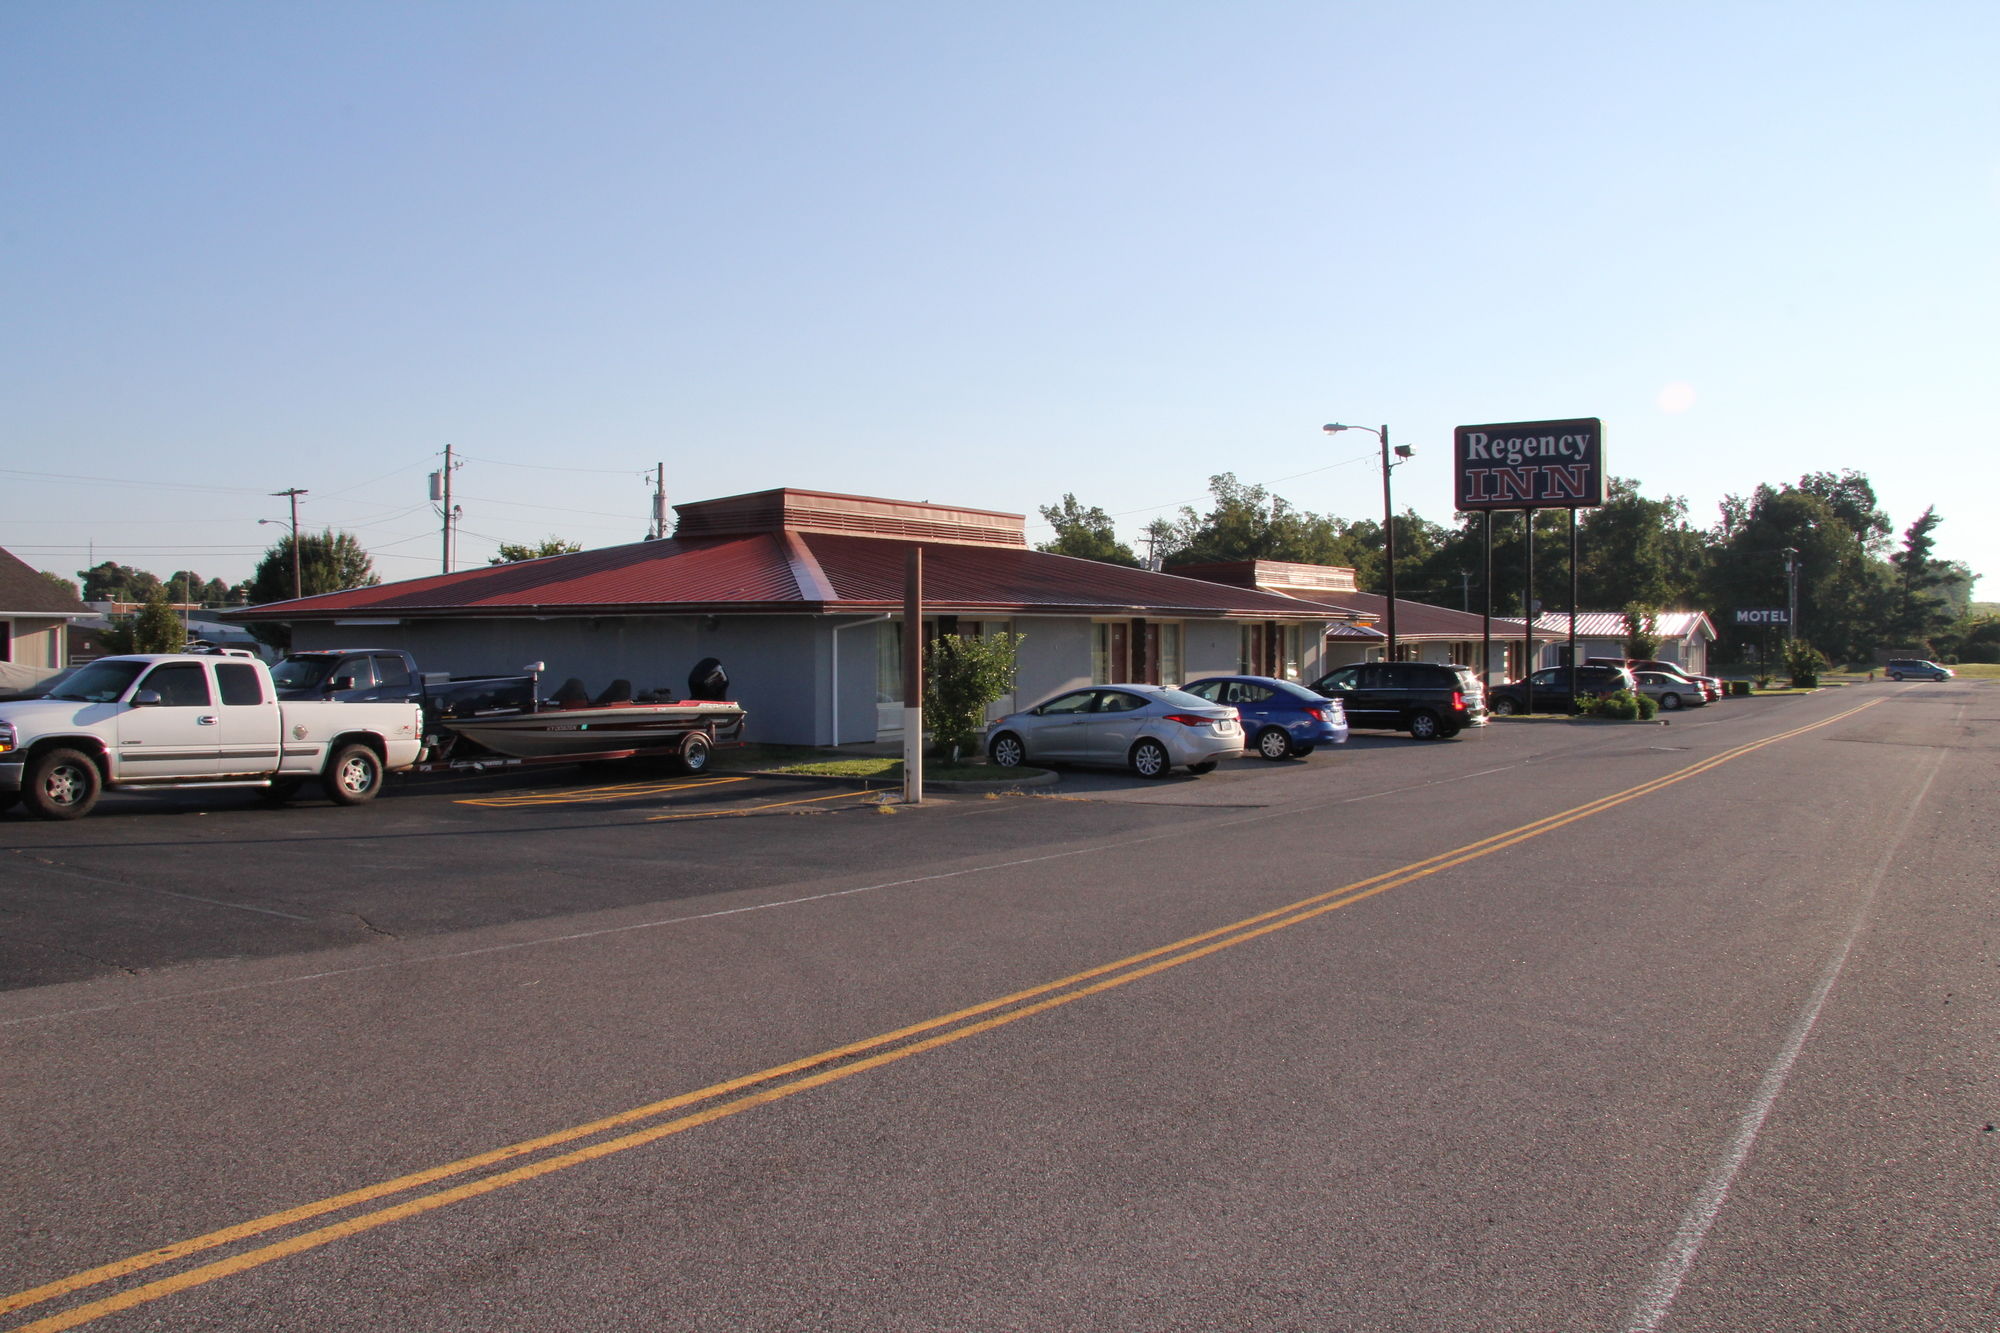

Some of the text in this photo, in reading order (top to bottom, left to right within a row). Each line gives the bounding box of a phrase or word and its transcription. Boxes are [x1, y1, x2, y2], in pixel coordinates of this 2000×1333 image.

[1466, 432, 1590, 465] Regency
[1466, 464, 1590, 501] INN
[1736, 610, 1788, 622] MOTEL
